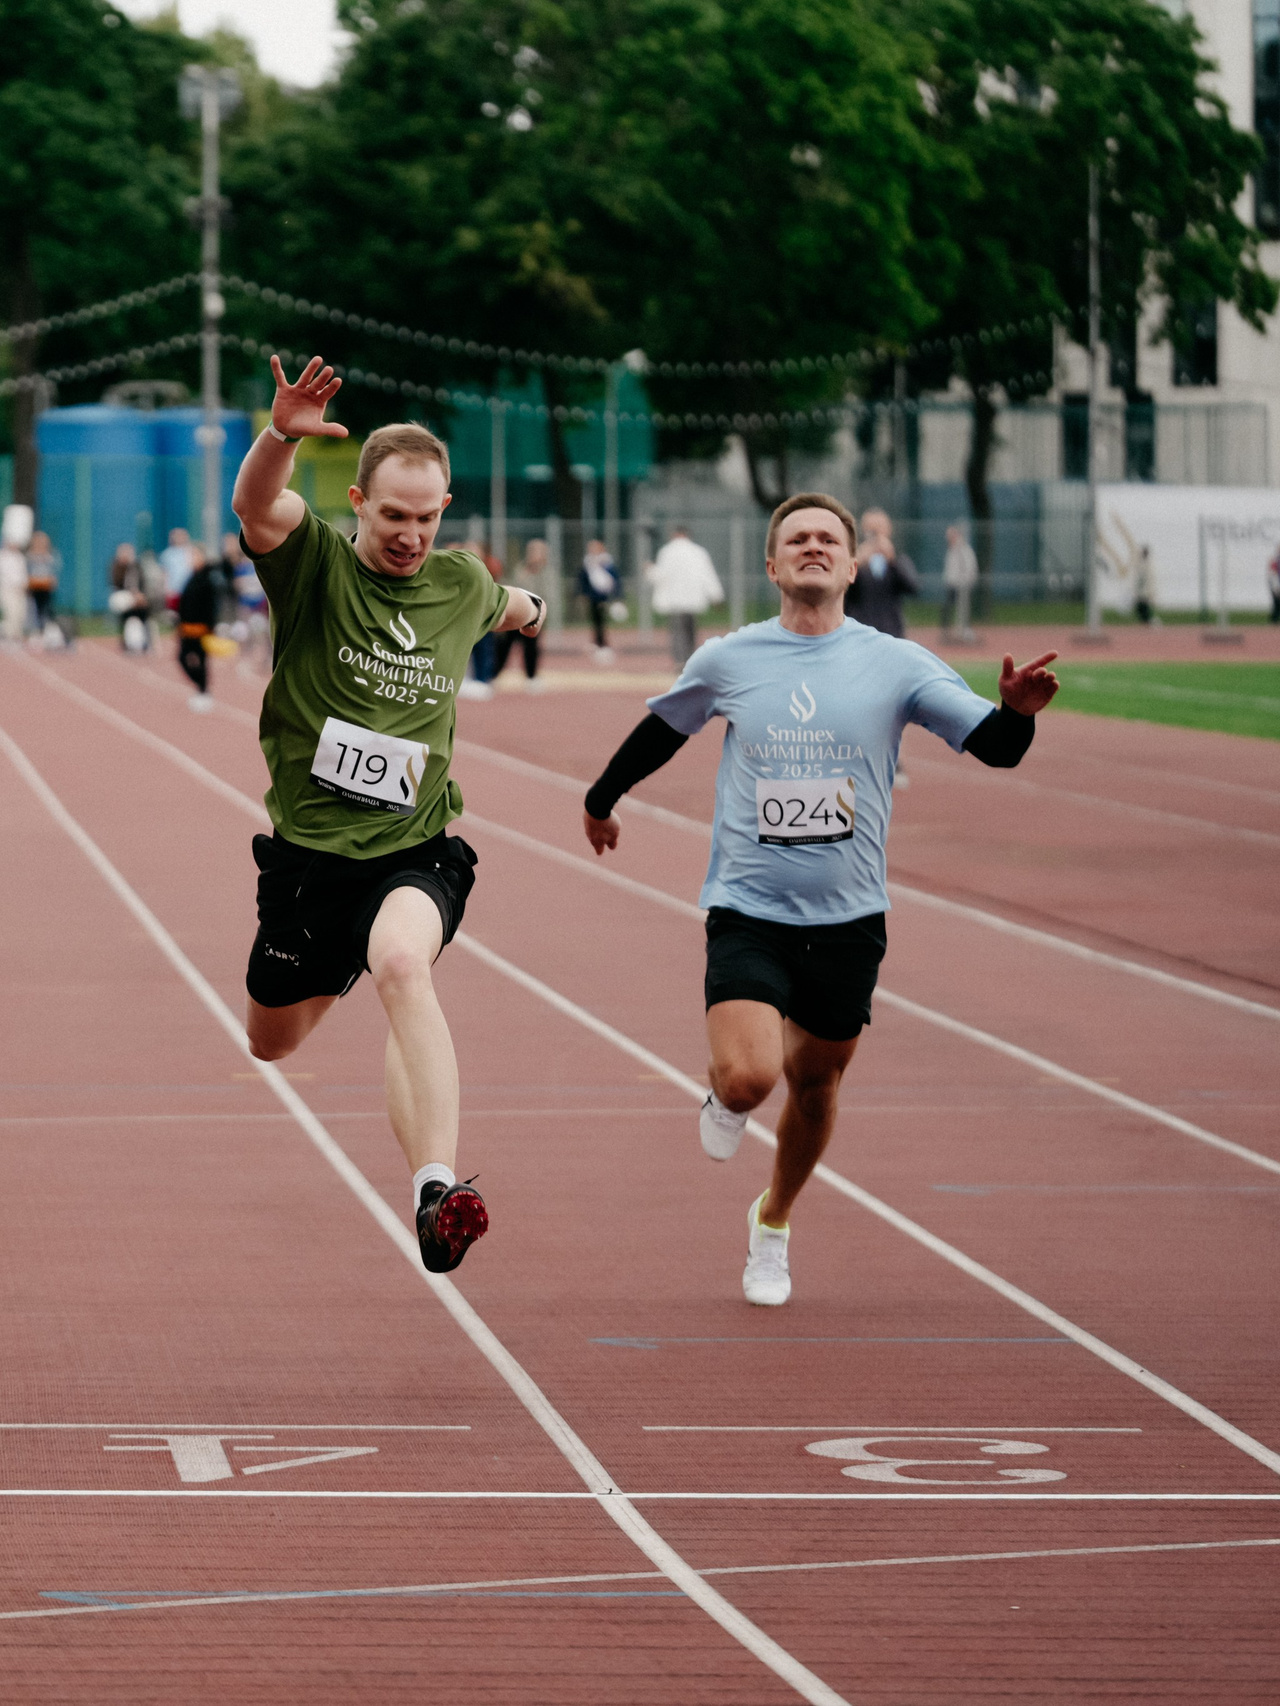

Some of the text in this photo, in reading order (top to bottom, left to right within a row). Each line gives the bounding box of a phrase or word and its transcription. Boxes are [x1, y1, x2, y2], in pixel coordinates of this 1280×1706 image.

[338, 646, 455, 694] ОЛИМПИАДА
[372, 641, 435, 670] Sminex
[374, 680, 418, 705] 2025
[767, 724, 835, 743] Sminex
[337, 742, 388, 785] 119
[742, 742, 864, 760] ОЛИМПИАДА
[781, 763, 823, 778] 2025
[763, 797, 834, 827] 024
[103, 1434, 379, 1483] 4
[804, 1436, 1068, 1485] 3
